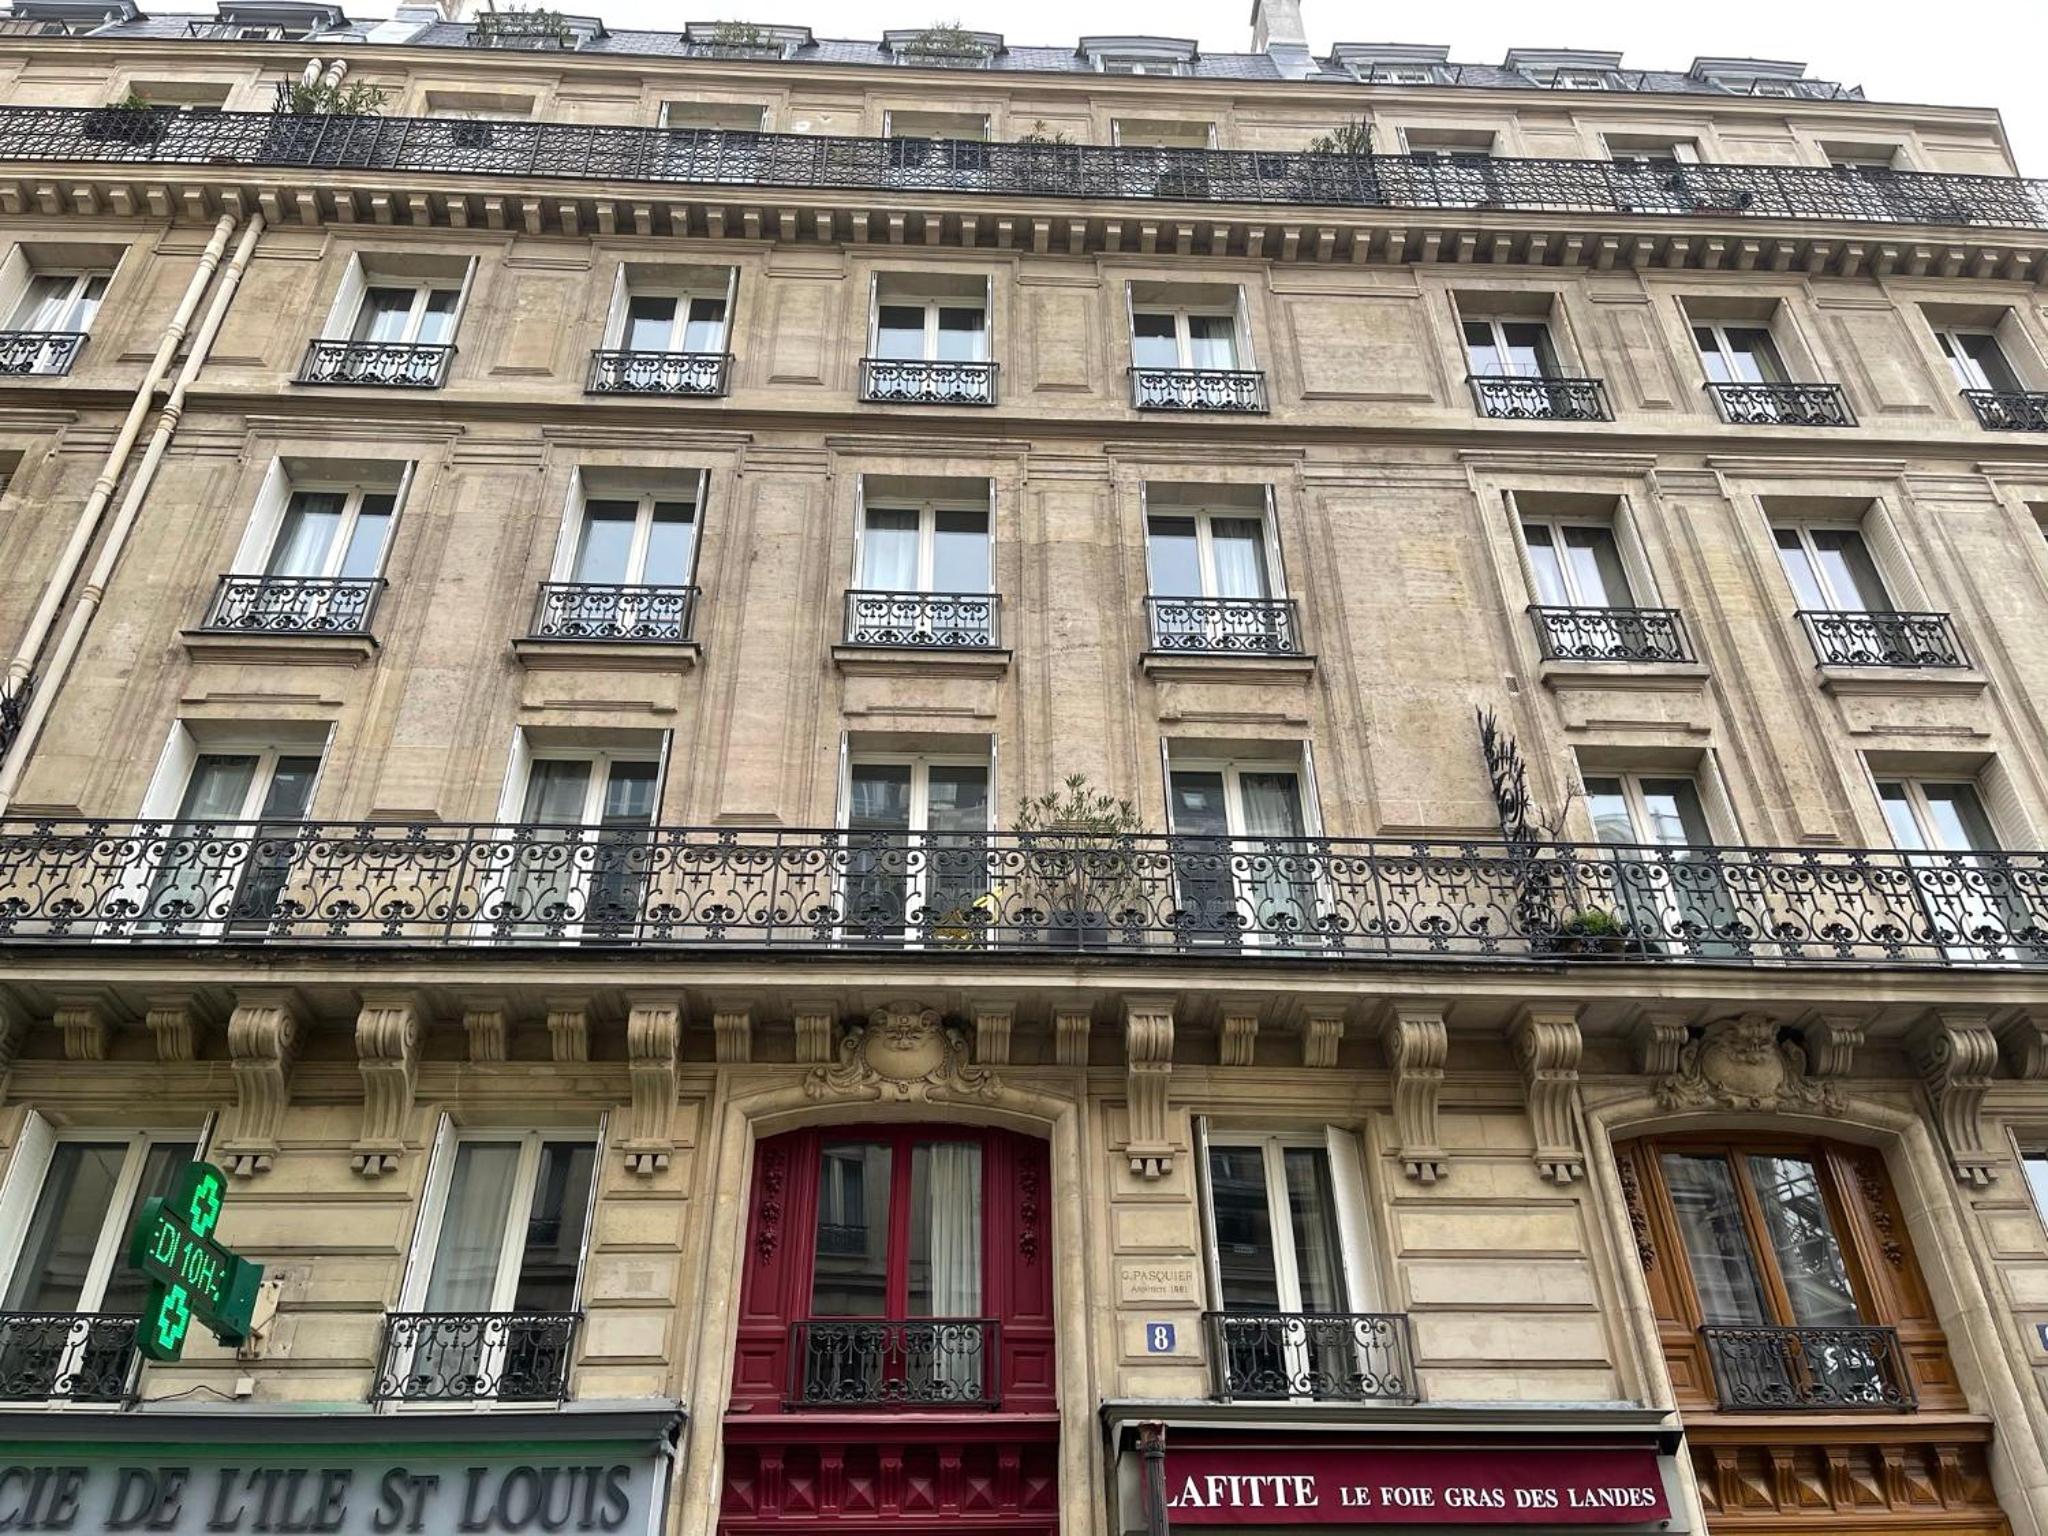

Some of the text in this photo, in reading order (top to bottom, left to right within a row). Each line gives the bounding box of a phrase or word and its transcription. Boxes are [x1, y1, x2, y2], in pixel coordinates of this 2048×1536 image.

[1154, 1326, 1168, 1350] 8
[104, 1466, 190, 1530] DE
[206, 1467, 353, 1532] L'ILE
[457, 1465, 631, 1532] LOUIS
[1167, 1475, 1656, 1508] AFITTE LE FOIE GRAS DES LANDES
